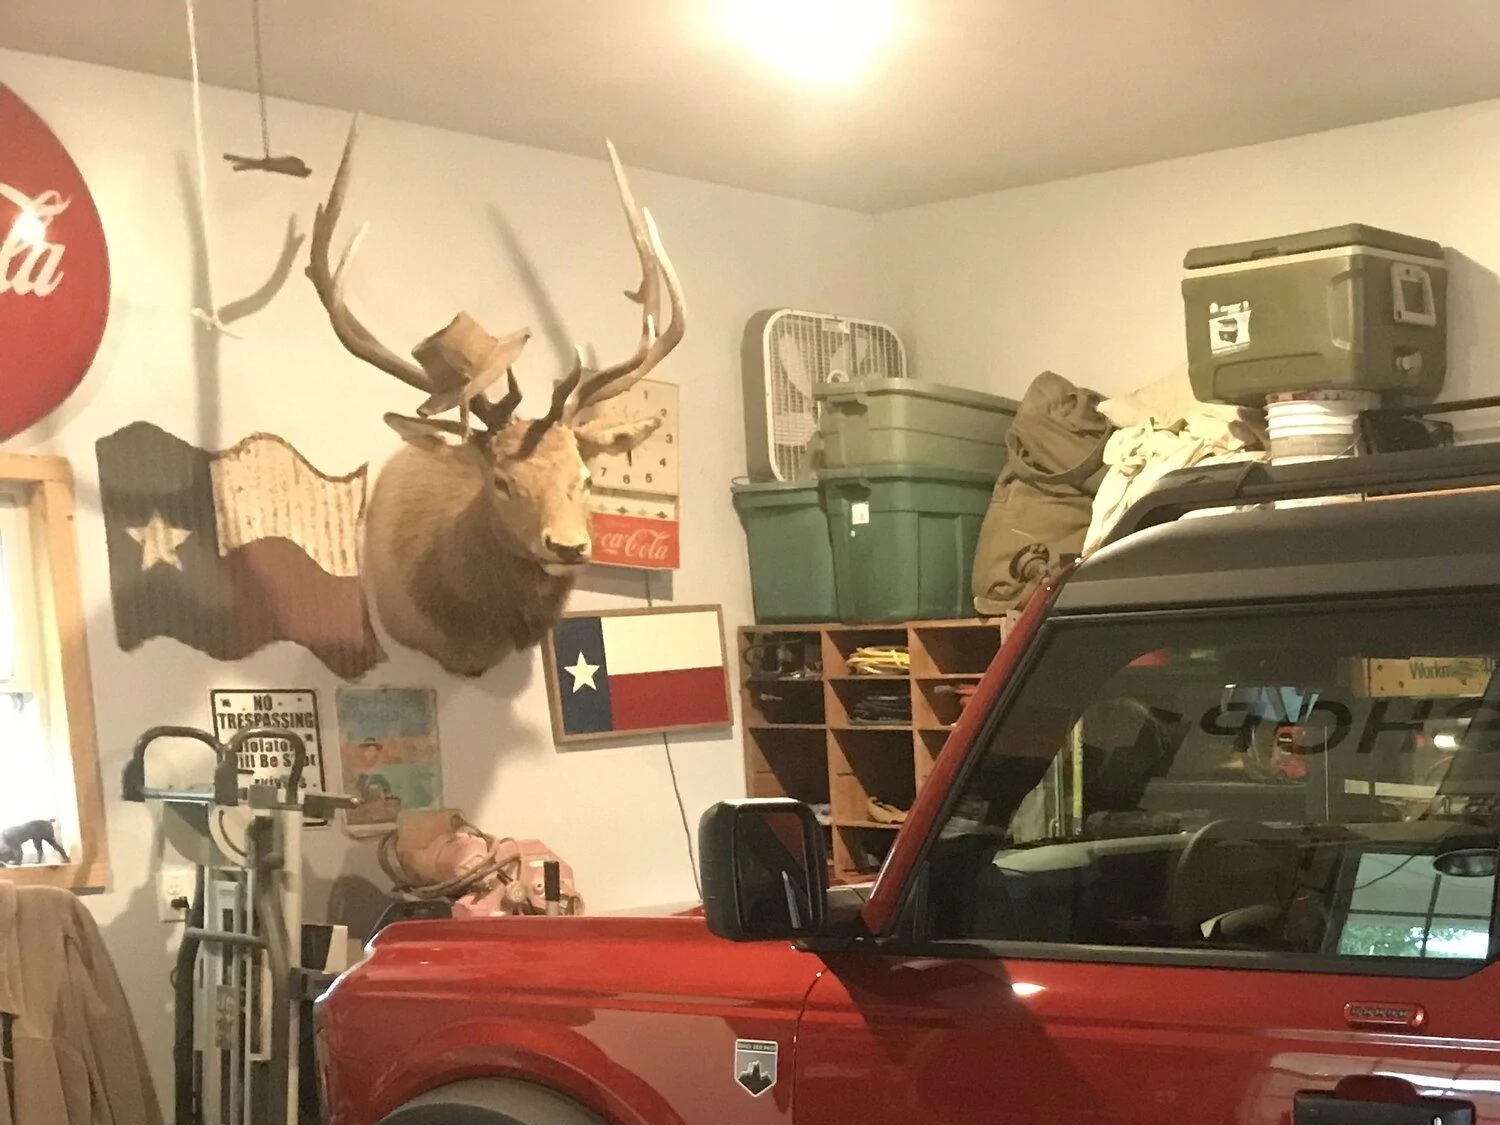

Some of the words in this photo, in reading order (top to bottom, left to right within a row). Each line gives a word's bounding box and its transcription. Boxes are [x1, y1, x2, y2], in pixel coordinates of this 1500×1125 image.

[665, 433, 674, 444] 3
[659, 458, 667, 468] 4
[600, 467, 607, 477] 7
[622, 474, 631, 485] 6
[645, 473, 653, 483] 5
[253, 694, 273, 711] NO
[217, 712, 314, 729] TRESPASSING
[260, 753, 279, 768] Be
